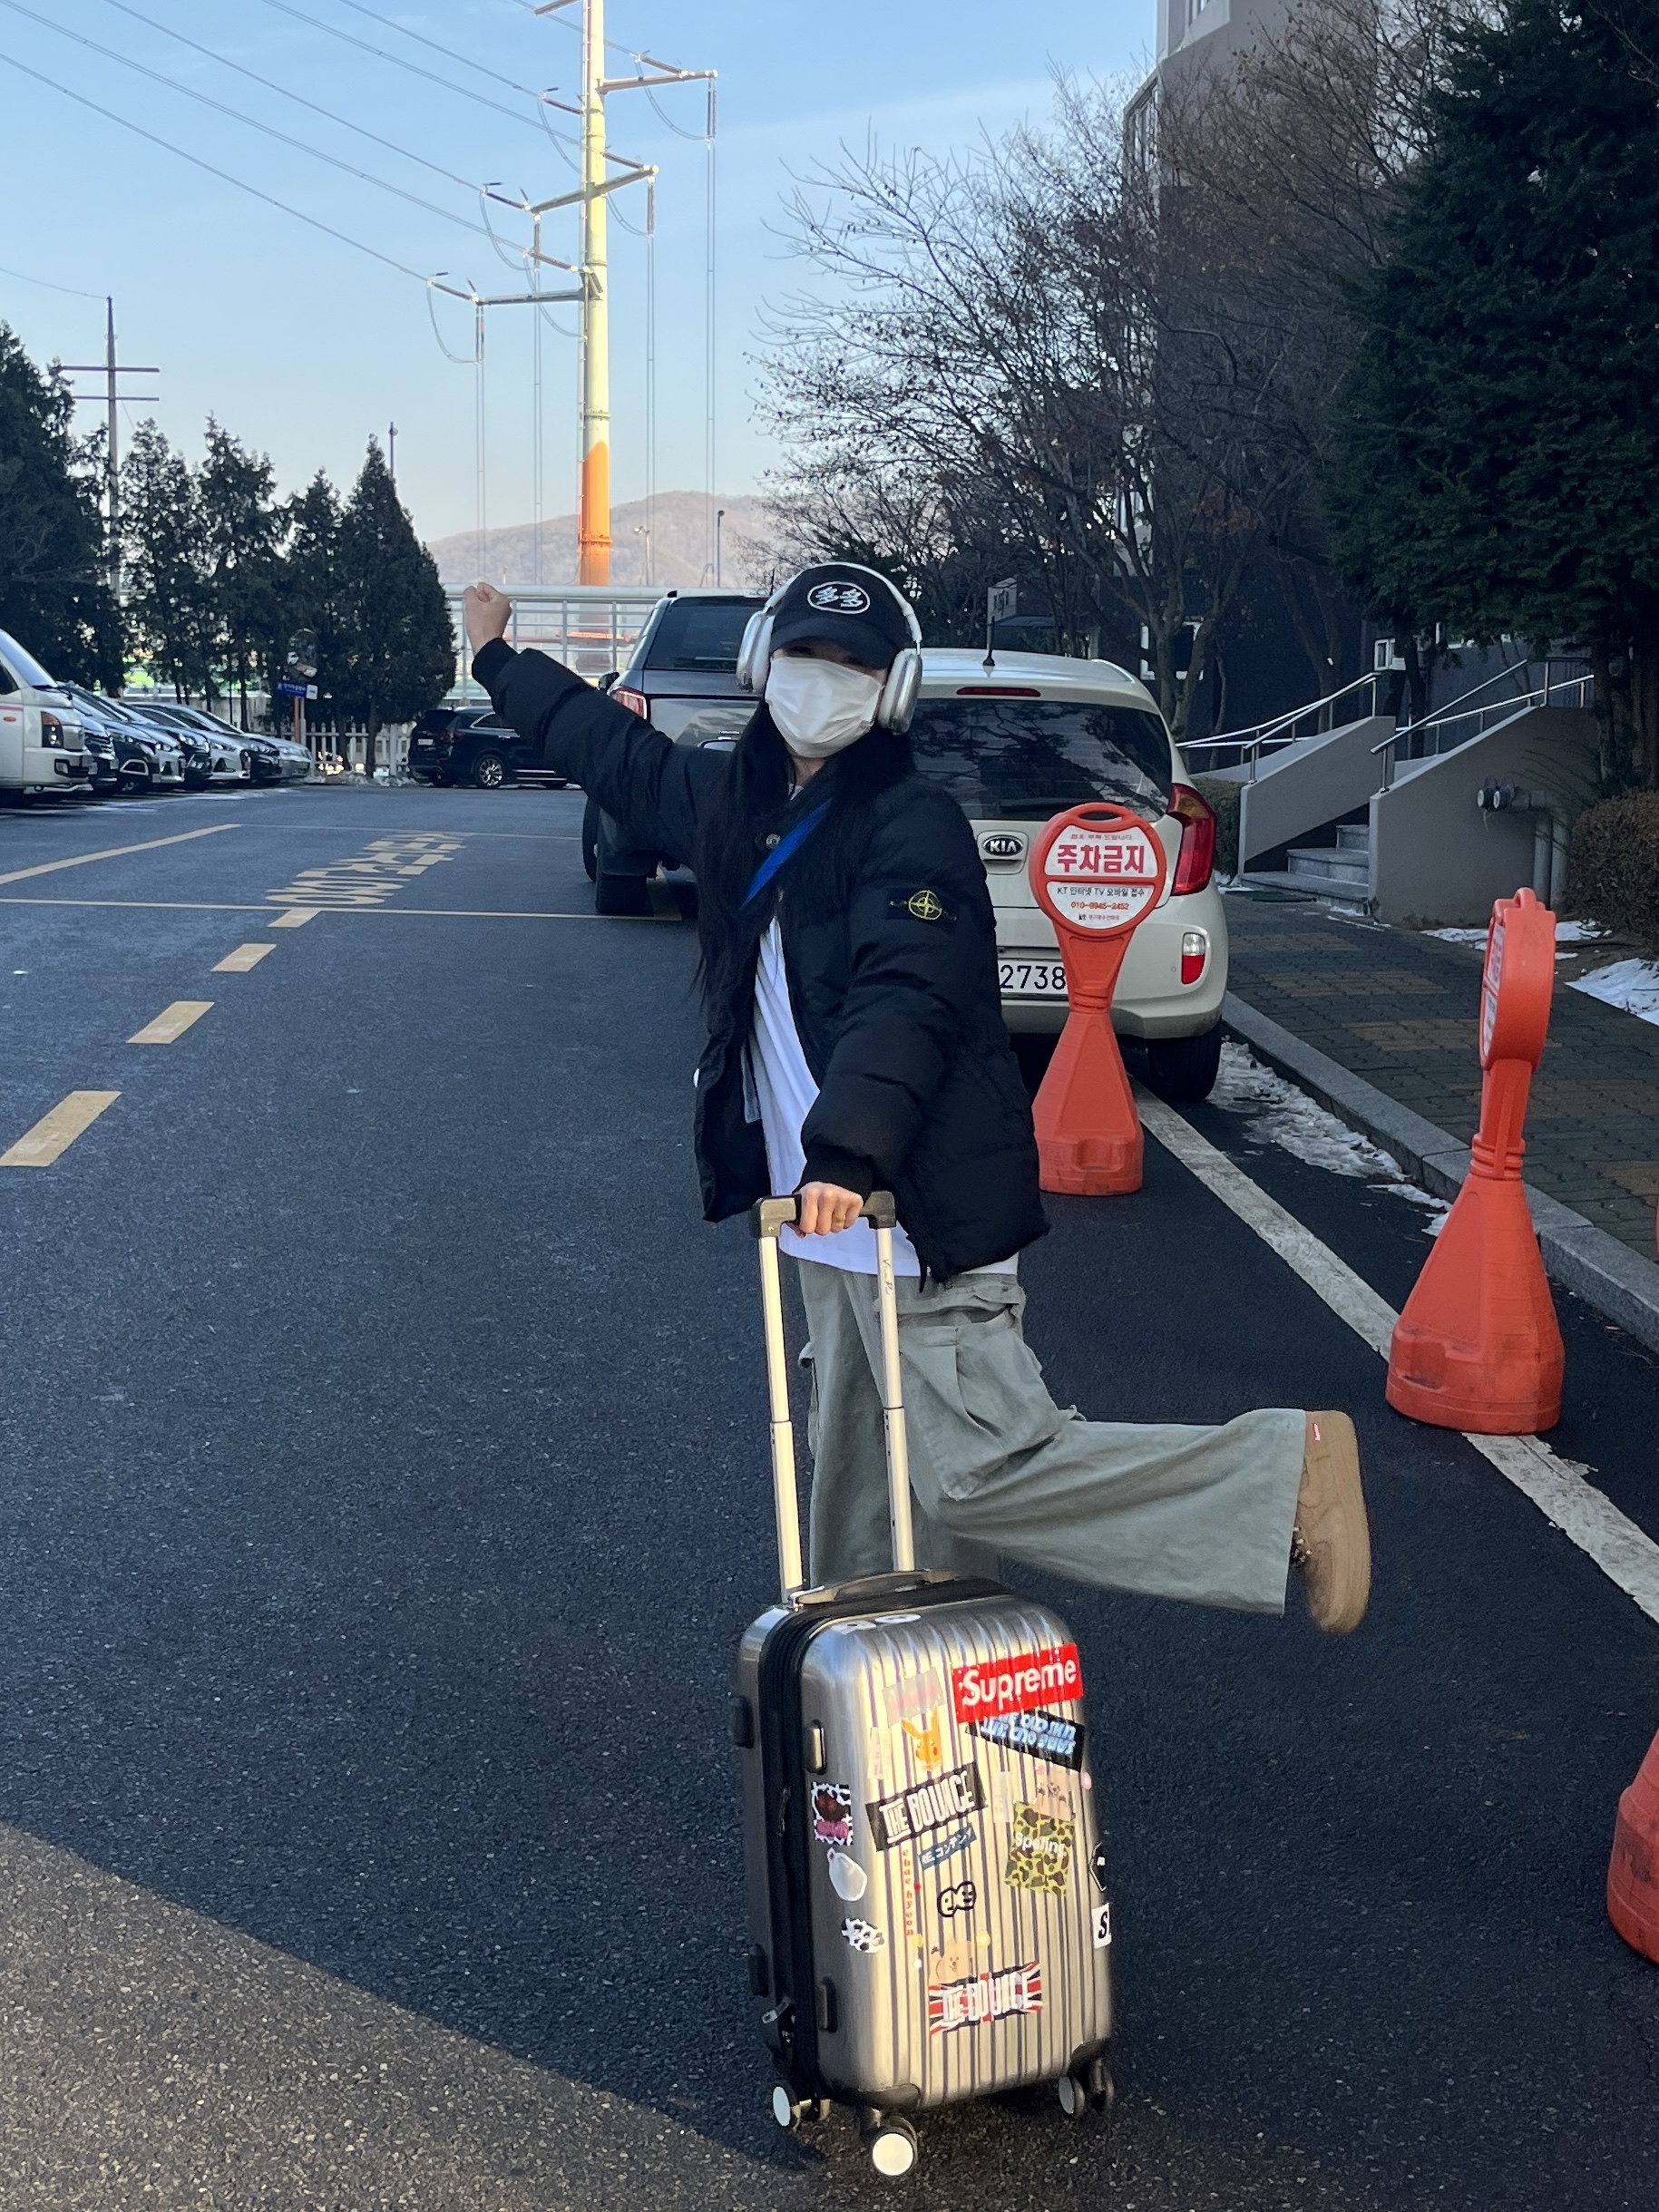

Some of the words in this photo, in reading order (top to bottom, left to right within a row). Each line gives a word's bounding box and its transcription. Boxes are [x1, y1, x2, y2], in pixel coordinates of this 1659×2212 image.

[990, 840, 1017, 853] KIA
[1058, 844, 1145, 874] 주차금지
[1057, 886, 1068, 895] KT
[1069, 887, 1093, 896] 인터넷
[1094, 887, 1106, 895] TV
[1000, 964, 1066, 990] 2738
[961, 1659, 1078, 1711] Supreme
[878, 1797, 912, 1845] THE
[906, 1769, 976, 1833] BOUNCE
[966, 1971, 1033, 2022] BOUNCE
